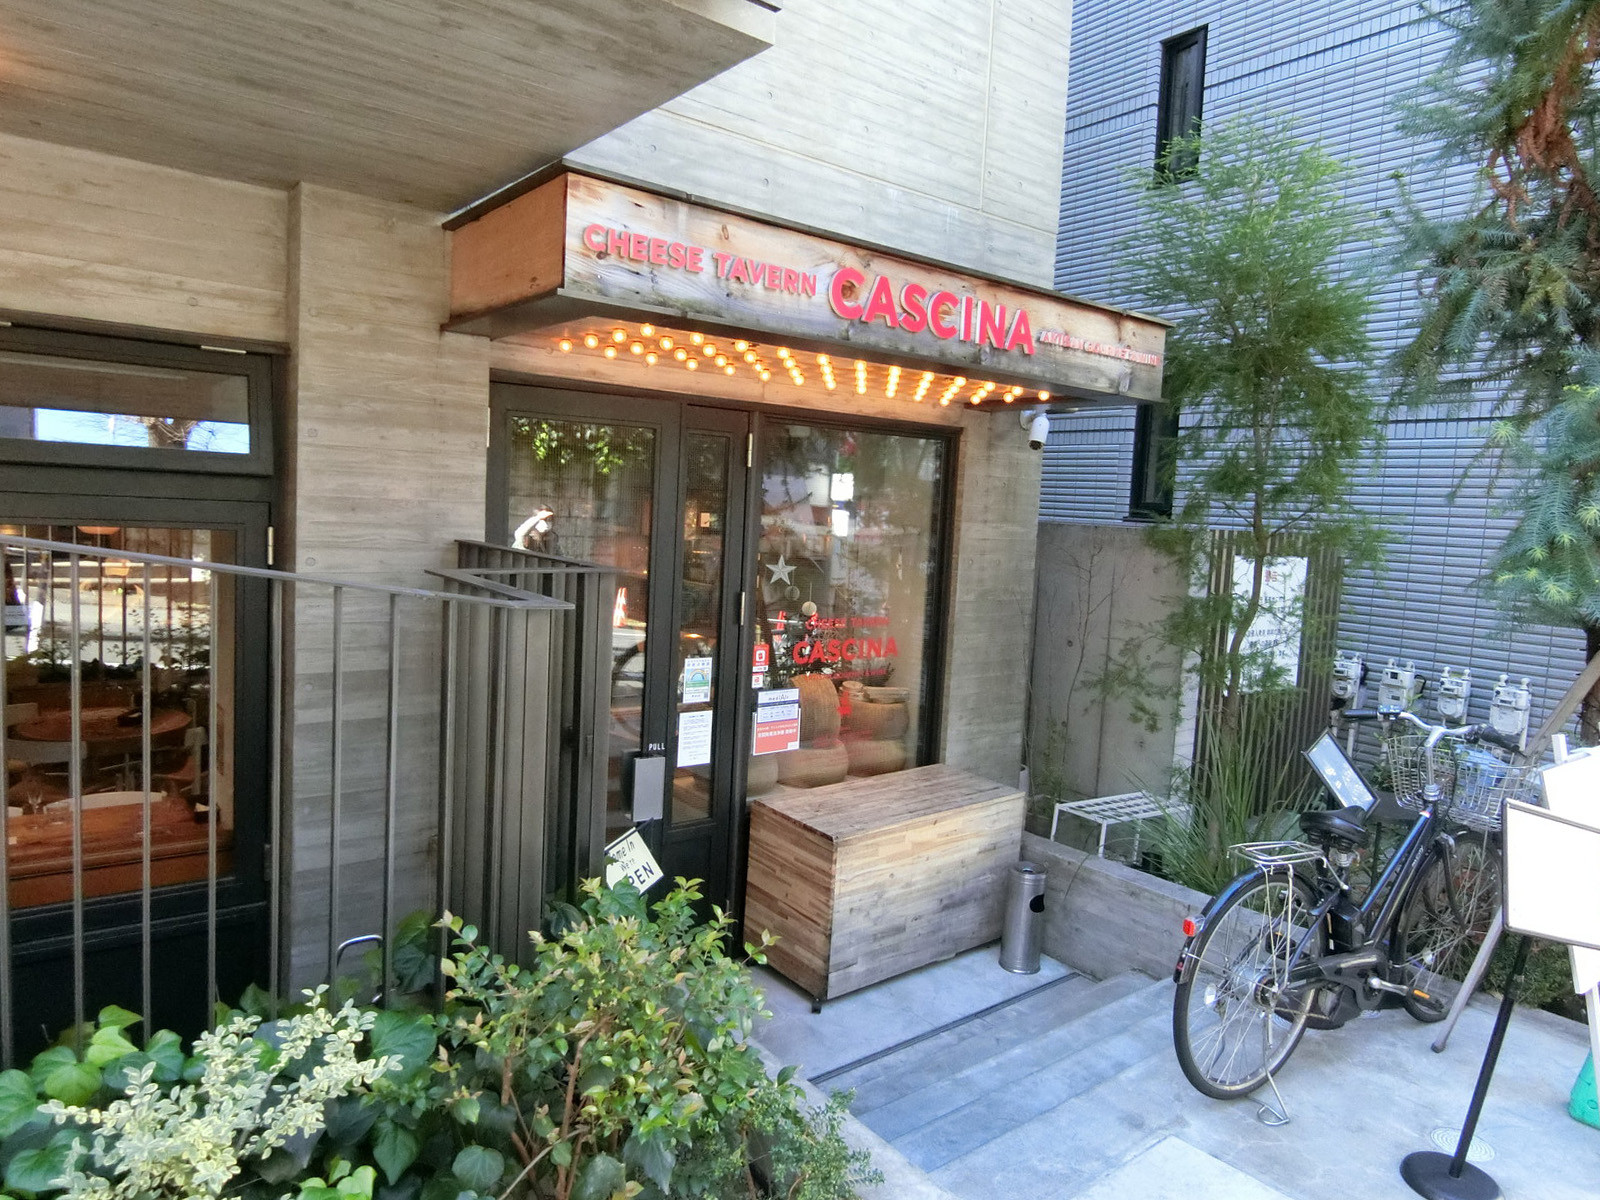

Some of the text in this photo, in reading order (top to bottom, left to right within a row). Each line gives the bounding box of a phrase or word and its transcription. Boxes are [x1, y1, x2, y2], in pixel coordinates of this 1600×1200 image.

[583, 223, 817, 297] CHEESE TAVERN
[828, 267, 1035, 355] CASCINA
[792, 636, 898, 665] CASCINA
[648, 742, 666, 751] PULL
[625, 838, 635, 852] In
[627, 861, 655, 886] PEN
